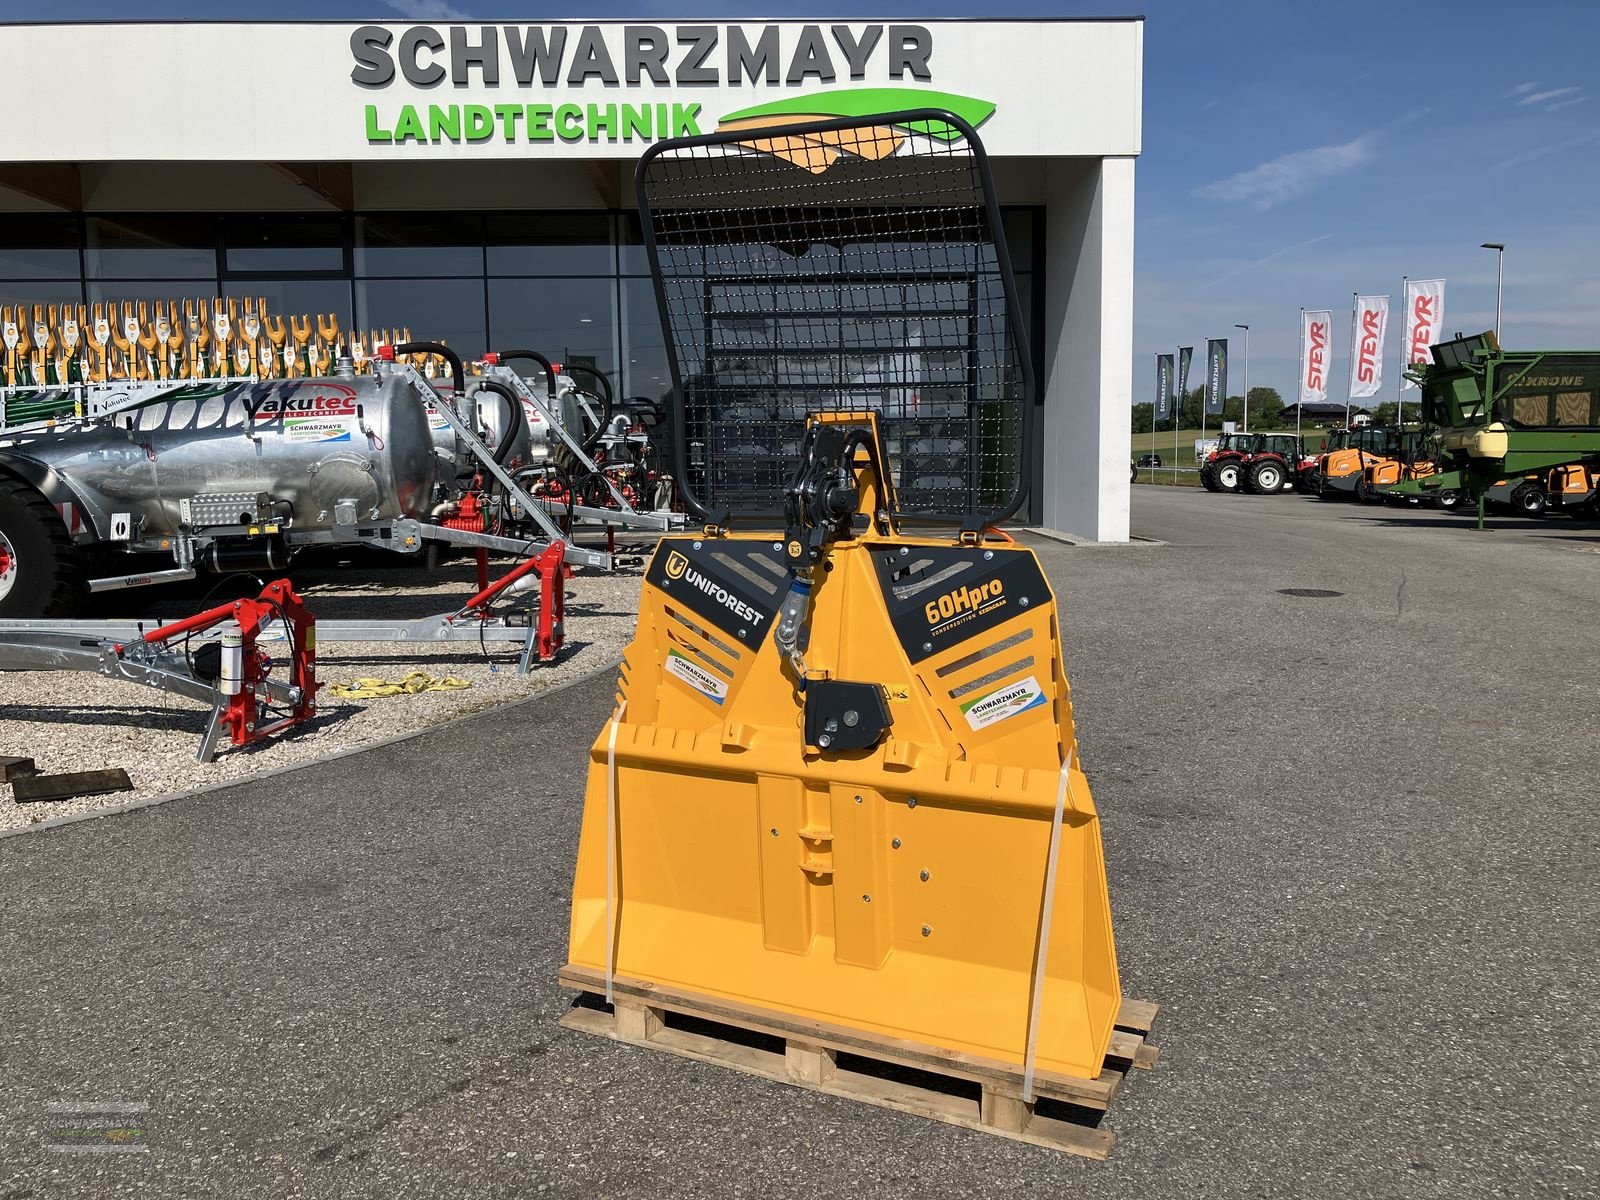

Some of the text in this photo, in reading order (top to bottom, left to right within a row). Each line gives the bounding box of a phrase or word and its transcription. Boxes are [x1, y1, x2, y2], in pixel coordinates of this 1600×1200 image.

[349, 24, 933, 86] SCHWARZMAYR
[365, 103, 702, 142] LANDTECHNIK
[1308, 321, 1325, 391] STEYR
[1358, 309, 1379, 384] STEYR
[243, 393, 357, 420] Vakutec
[290, 424, 342, 432] SCHWARZMAYR
[685, 567, 764, 627] UNIFOREST
[925, 579, 1003, 624] 60Hpro
[674, 657, 717, 688] SCHWARZMAYR
[971, 688, 1027, 715] SCHWARZMAYR
